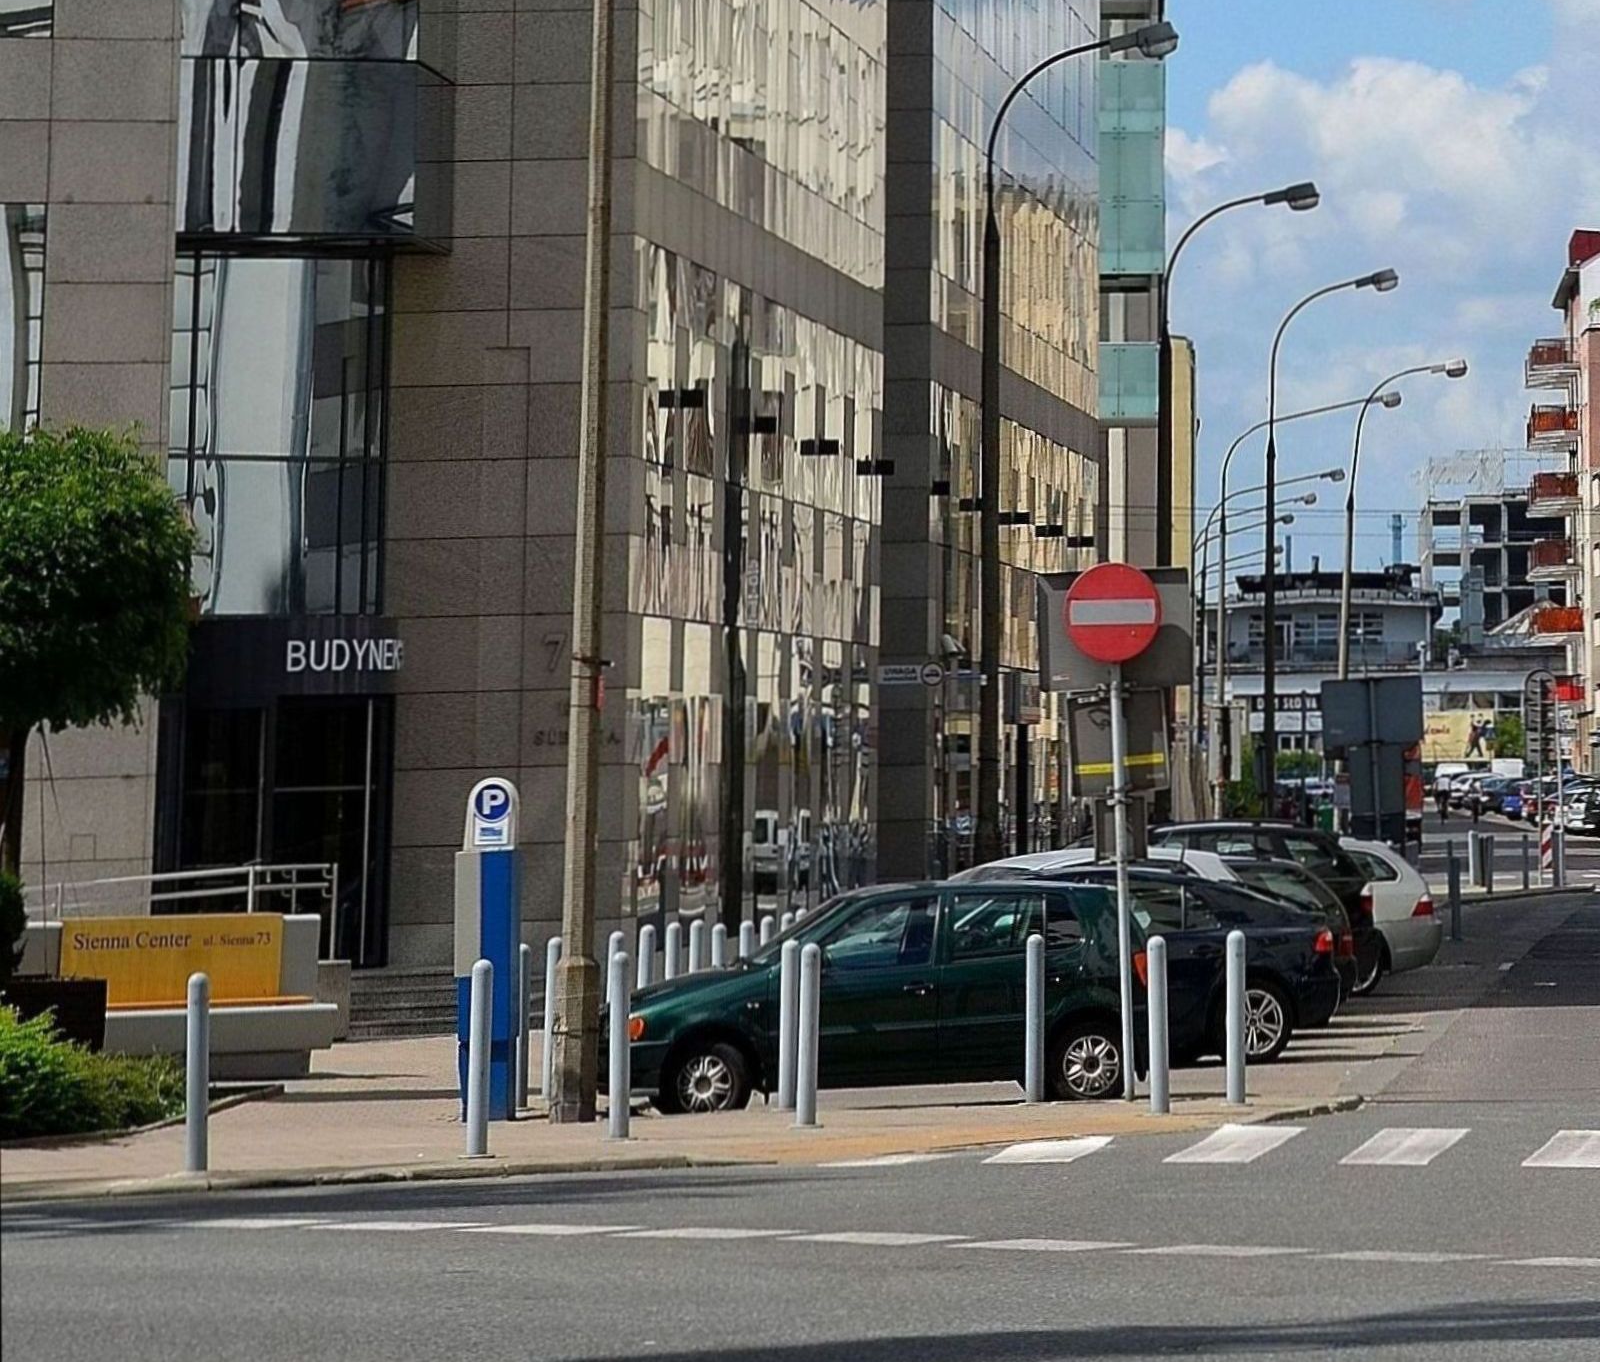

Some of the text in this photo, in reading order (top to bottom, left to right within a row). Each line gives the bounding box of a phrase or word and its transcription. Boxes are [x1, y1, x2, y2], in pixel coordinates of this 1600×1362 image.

[286, 638, 403, 672] BUDYNEK
[482, 789, 506, 815] P
[73, 932, 130, 951] Sienna
[135, 931, 193, 949] Center
[219, 933, 255, 946] Sienna
[257, 931, 272, 945] 73
